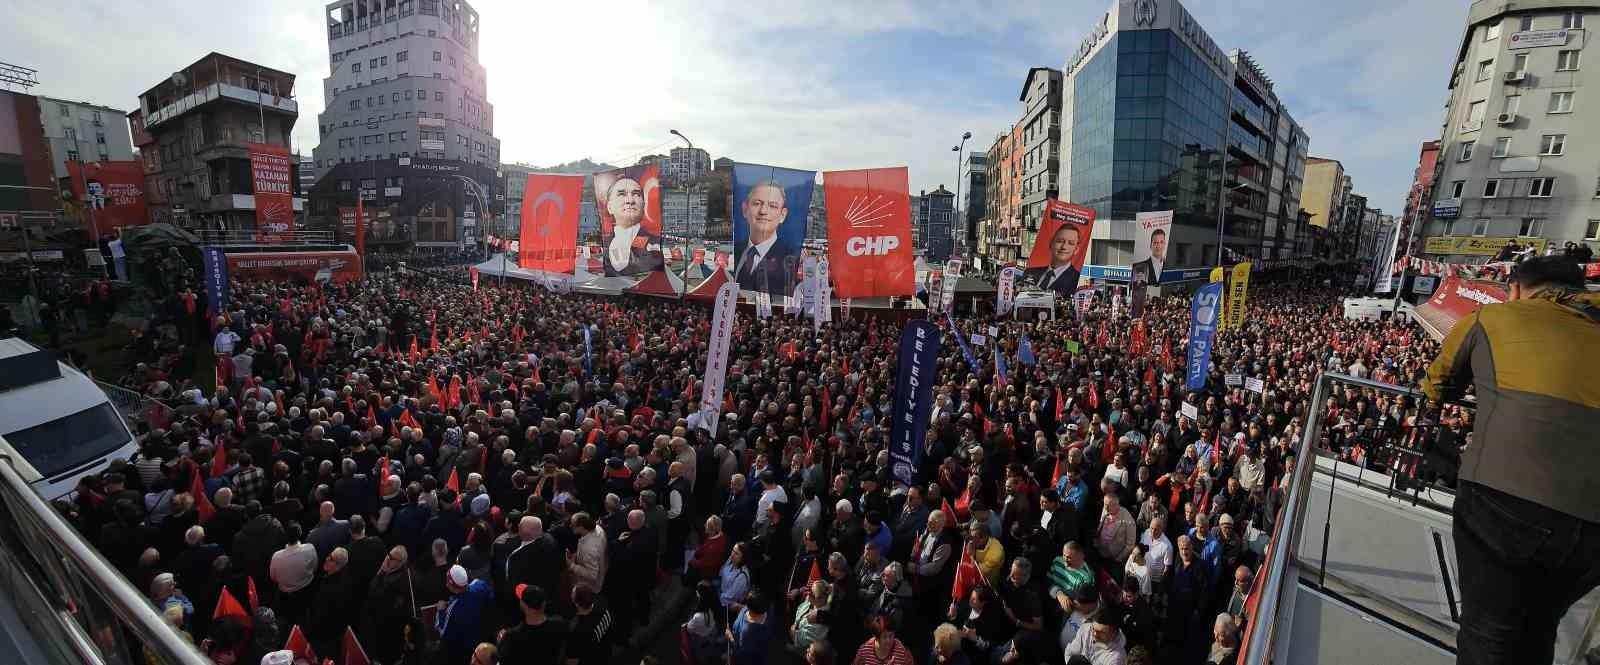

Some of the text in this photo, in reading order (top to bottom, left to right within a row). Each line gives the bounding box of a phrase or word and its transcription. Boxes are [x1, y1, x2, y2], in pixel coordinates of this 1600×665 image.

[255, 169, 288, 181] KAZANAN
[255, 179, 289, 192] TÜRKİYE
[846, 235, 899, 257] CHP
[714, 289, 730, 370] BELEDİYE
[1191, 292, 1217, 380] SOL PARTİ
[904, 327, 926, 424] BELEDİYE
